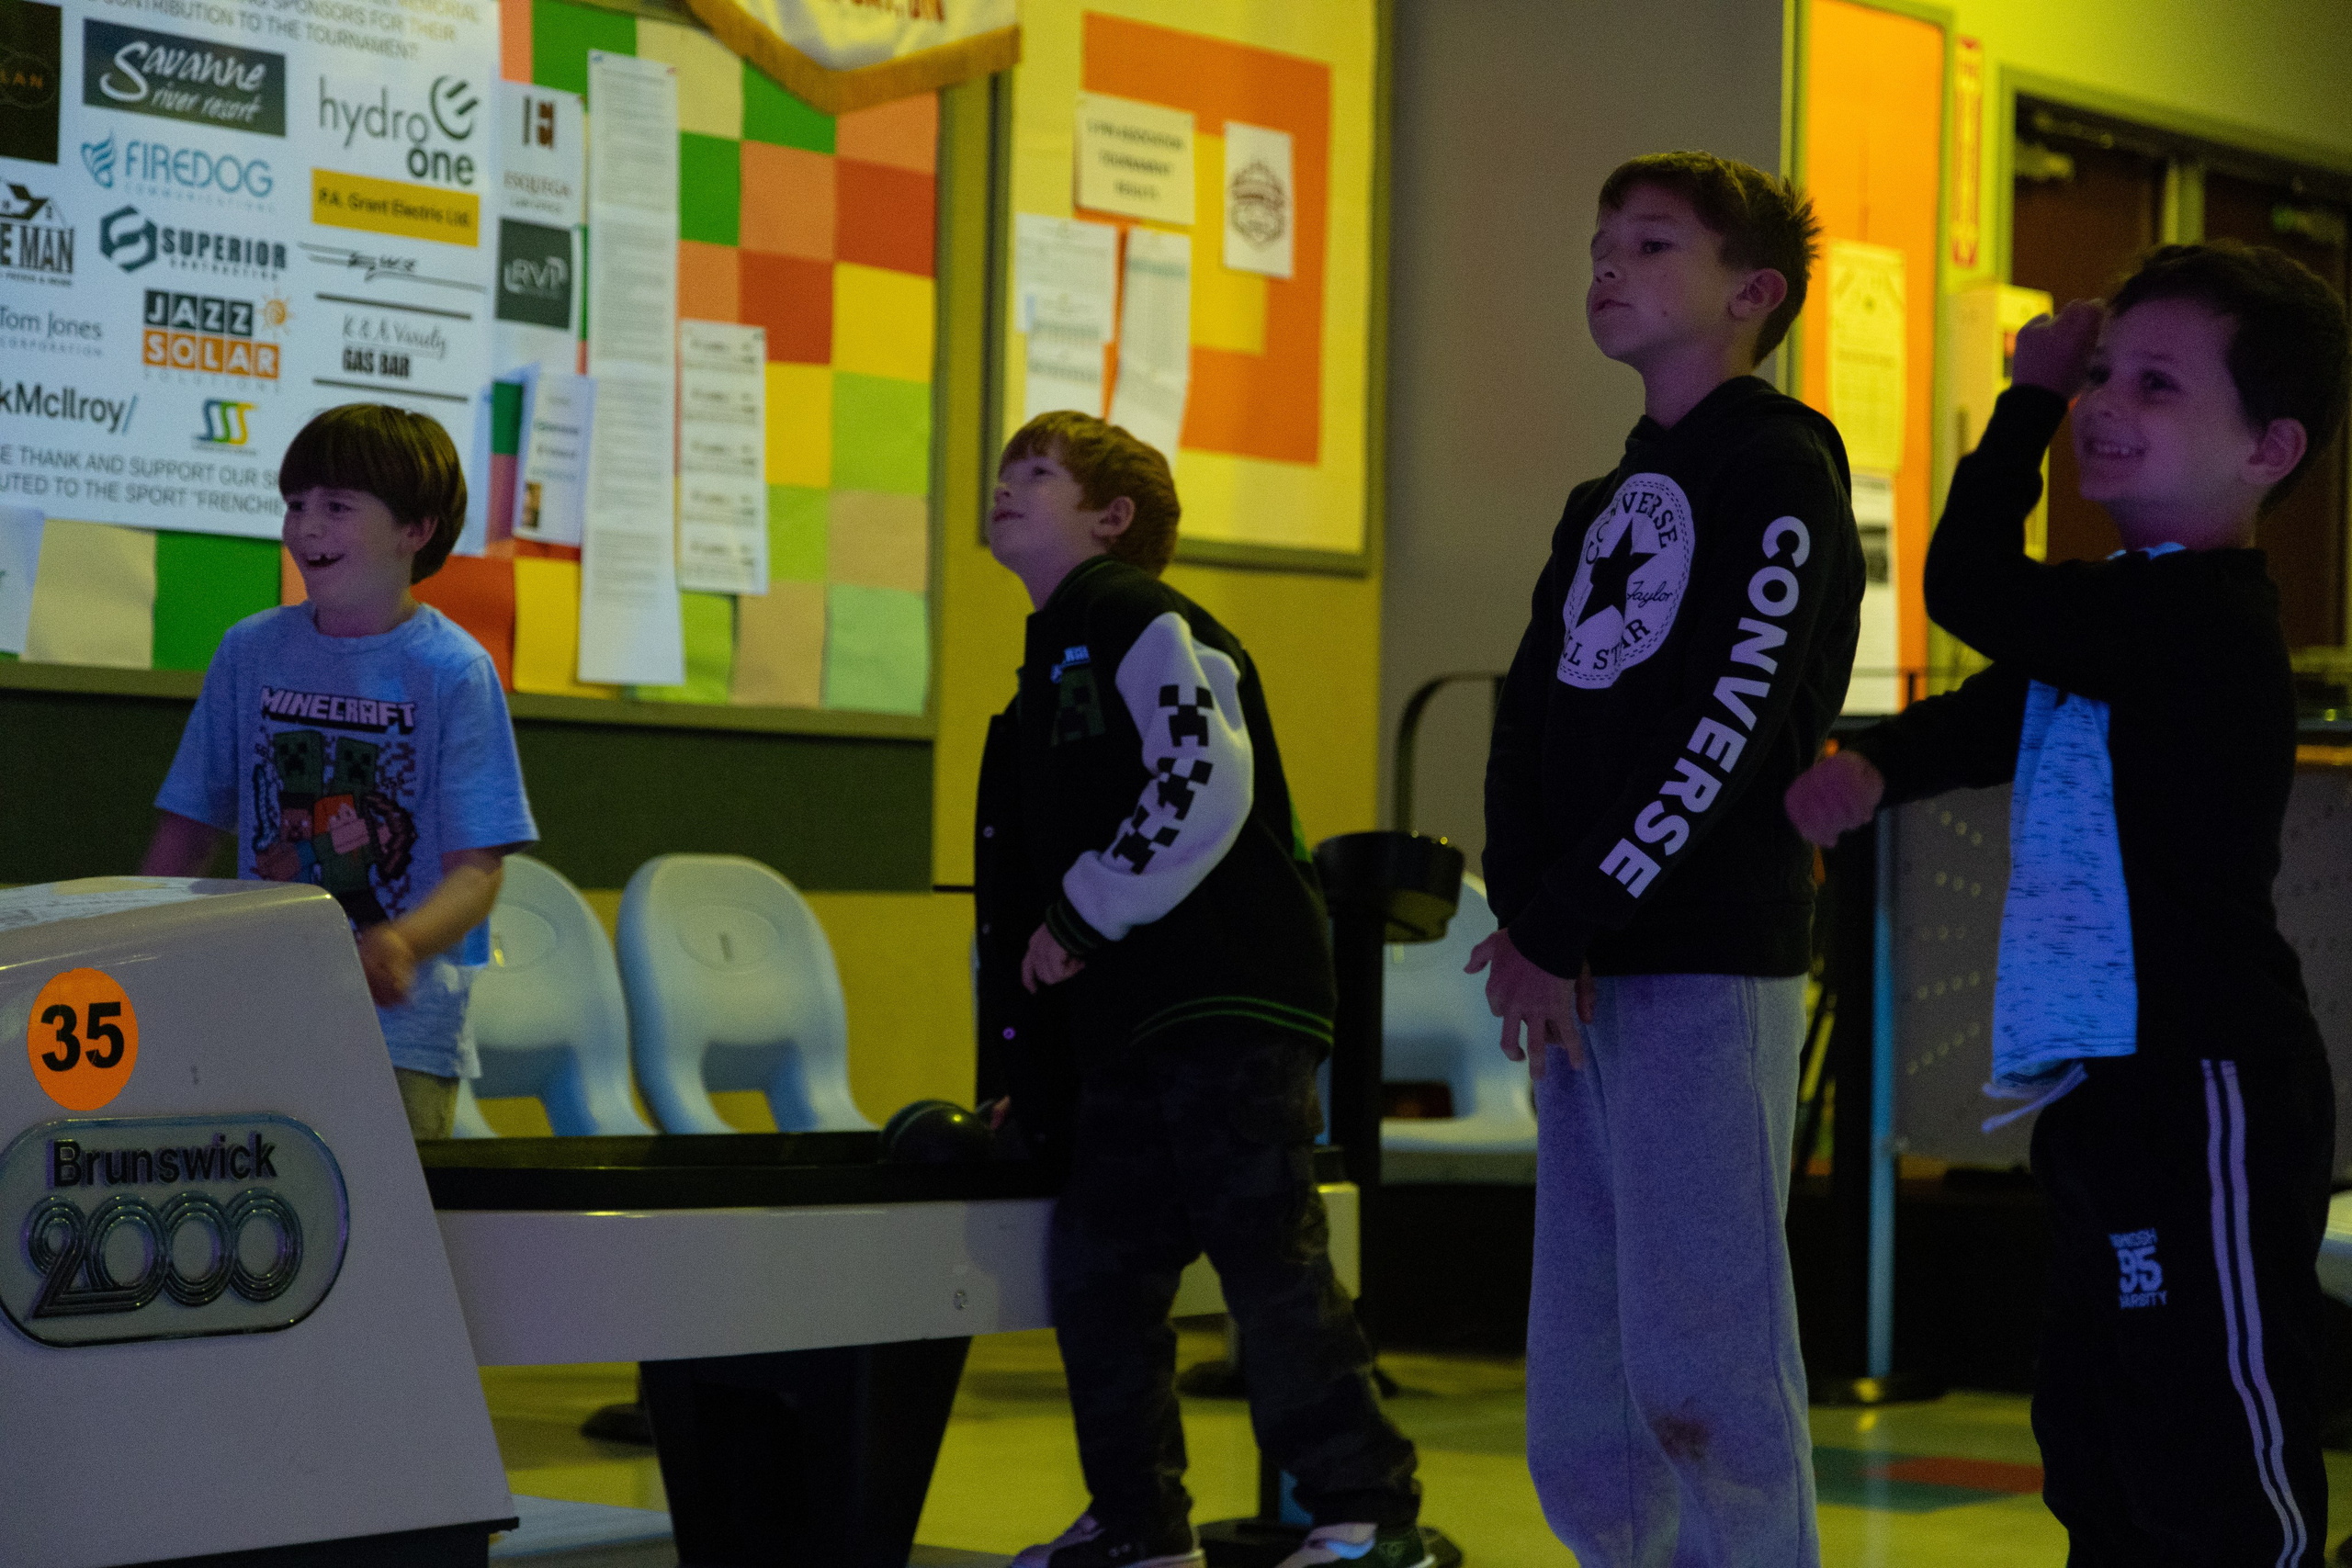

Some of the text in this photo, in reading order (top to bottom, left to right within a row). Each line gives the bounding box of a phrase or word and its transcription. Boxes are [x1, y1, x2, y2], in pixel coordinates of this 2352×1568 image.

[99, 40, 267, 102] Savanne
[151, 81, 261, 123] river resort
[318, 73, 430, 150] hydro
[125, 140, 274, 198] FIREDOG
[406, 145, 475, 186] one
[19, 226, 74, 275] MAN
[163, 229, 286, 269] SUPERIOR
[47, 310, 103, 342] Jones
[145, 290, 253, 336] JAZZ
[144, 329, 279, 378] SOLAR
[342, 346, 412, 378] GAS BAR
[18, 446, 81, 470] THANK
[85, 455, 124, 476] AND
[129, 457, 217, 484] SUPPORT
[219, 466, 258, 488] OUR
[54, 478, 81, 498] TO
[84, 480, 121, 502] THE
[125, 484, 187, 507] SPORT
[261, 686, 416, 734] MINECRAFT
[1599, 515, 1811, 899] CONVERSE
[40, 1001, 125, 1073] 35
[50, 1133, 278, 1188] Brunswick
[28, 1187, 304, 1320] 2000
